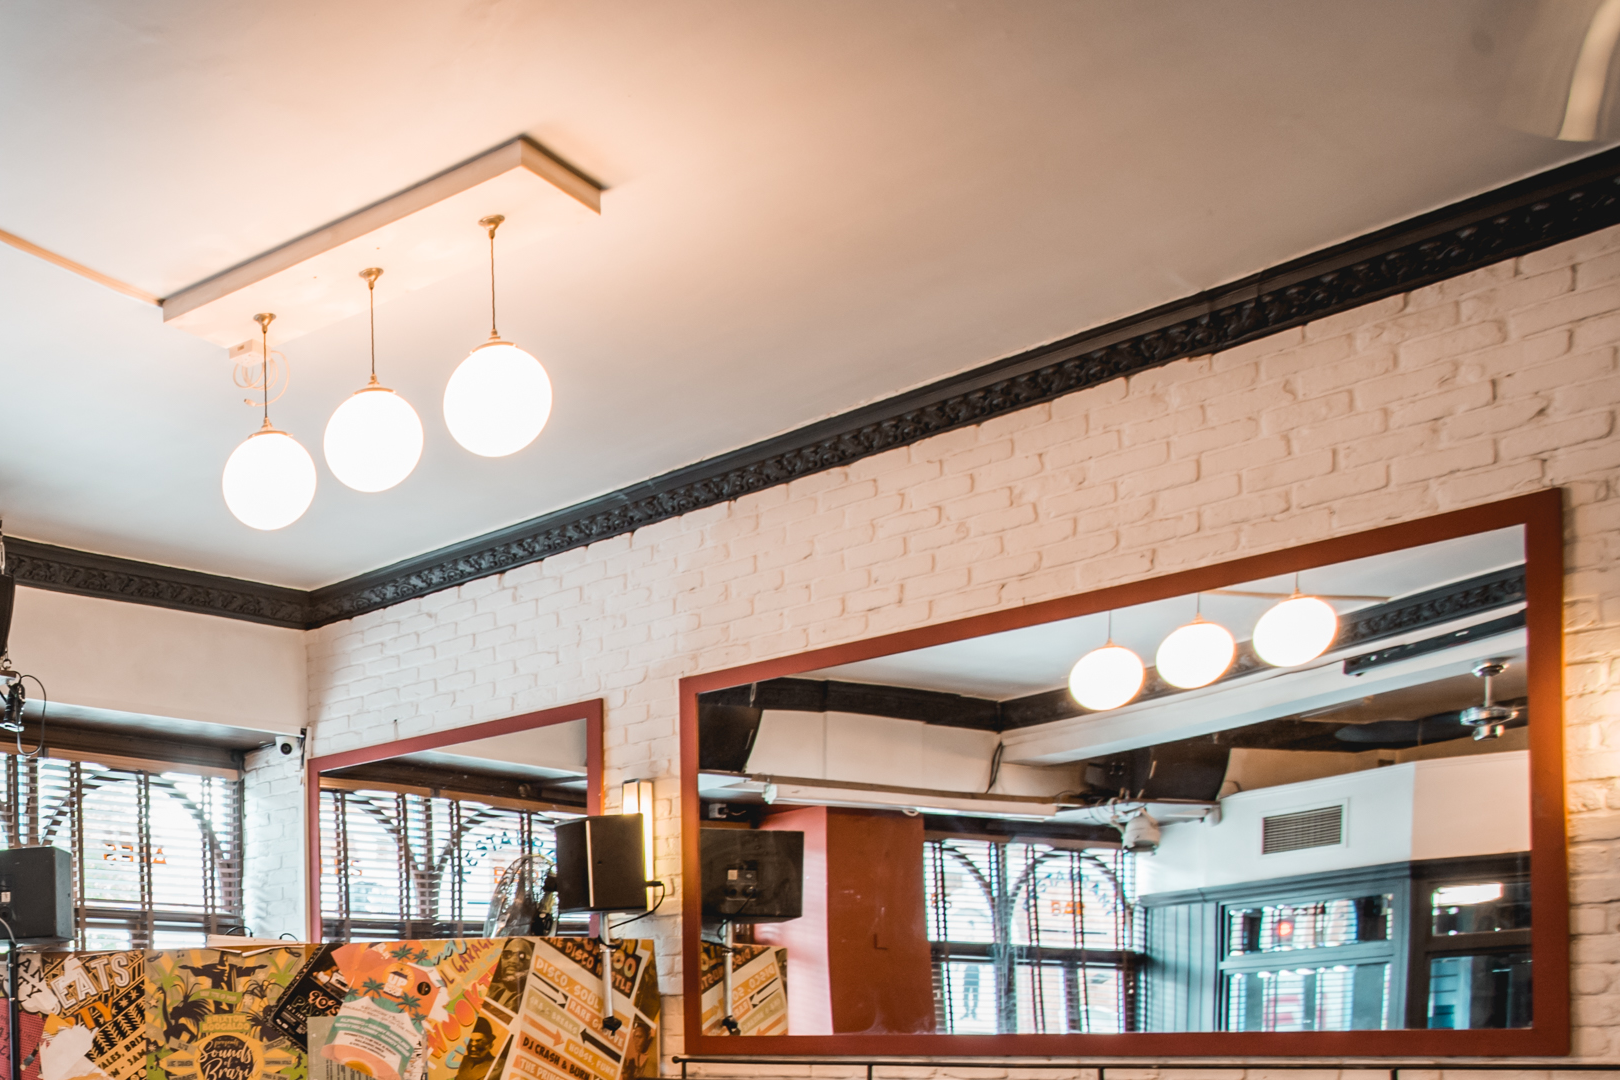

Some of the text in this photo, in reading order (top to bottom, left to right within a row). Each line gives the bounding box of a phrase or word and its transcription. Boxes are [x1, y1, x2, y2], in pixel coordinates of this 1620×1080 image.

[564, 941, 595, 969] DISCO
[535, 957, 570, 991] DISCO,
[573, 983, 600, 1010] SOUL
[568, 998, 591, 1021] RARE
[201, 1022, 251, 1032] BOOGALOO
[551, 1011, 579, 1036] BREAKS
[197, 1038, 254, 1064] Sounds
[223, 1057, 232, 1067] of
[522, 1036, 534, 1050] DJ
[534, 1042, 561, 1066] CRASH
[561, 1060, 567, 1070] &
[520, 1058, 535, 1074] THE
[595, 1059, 616, 1078] FUNK
